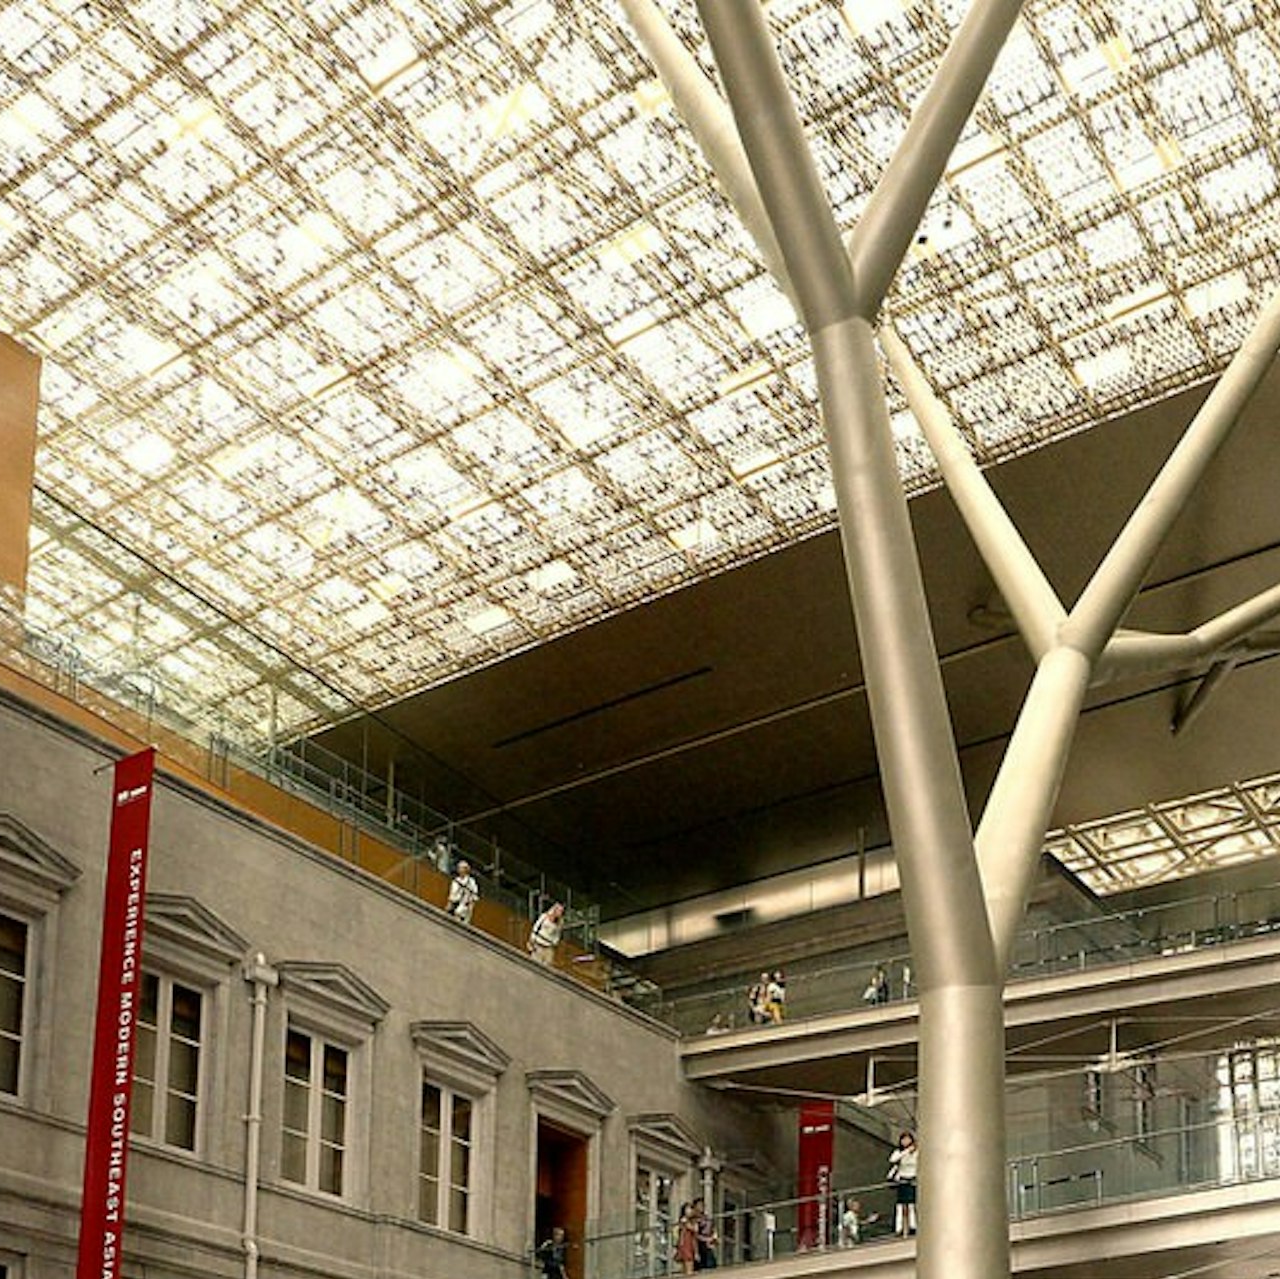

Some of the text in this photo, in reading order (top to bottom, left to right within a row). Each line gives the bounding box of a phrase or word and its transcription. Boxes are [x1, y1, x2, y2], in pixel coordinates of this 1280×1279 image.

[121, 848, 142, 985] EXPERIENCE
[115, 992, 133, 1086] MODERN
[105, 1093, 126, 1223] SOUTHEAST
